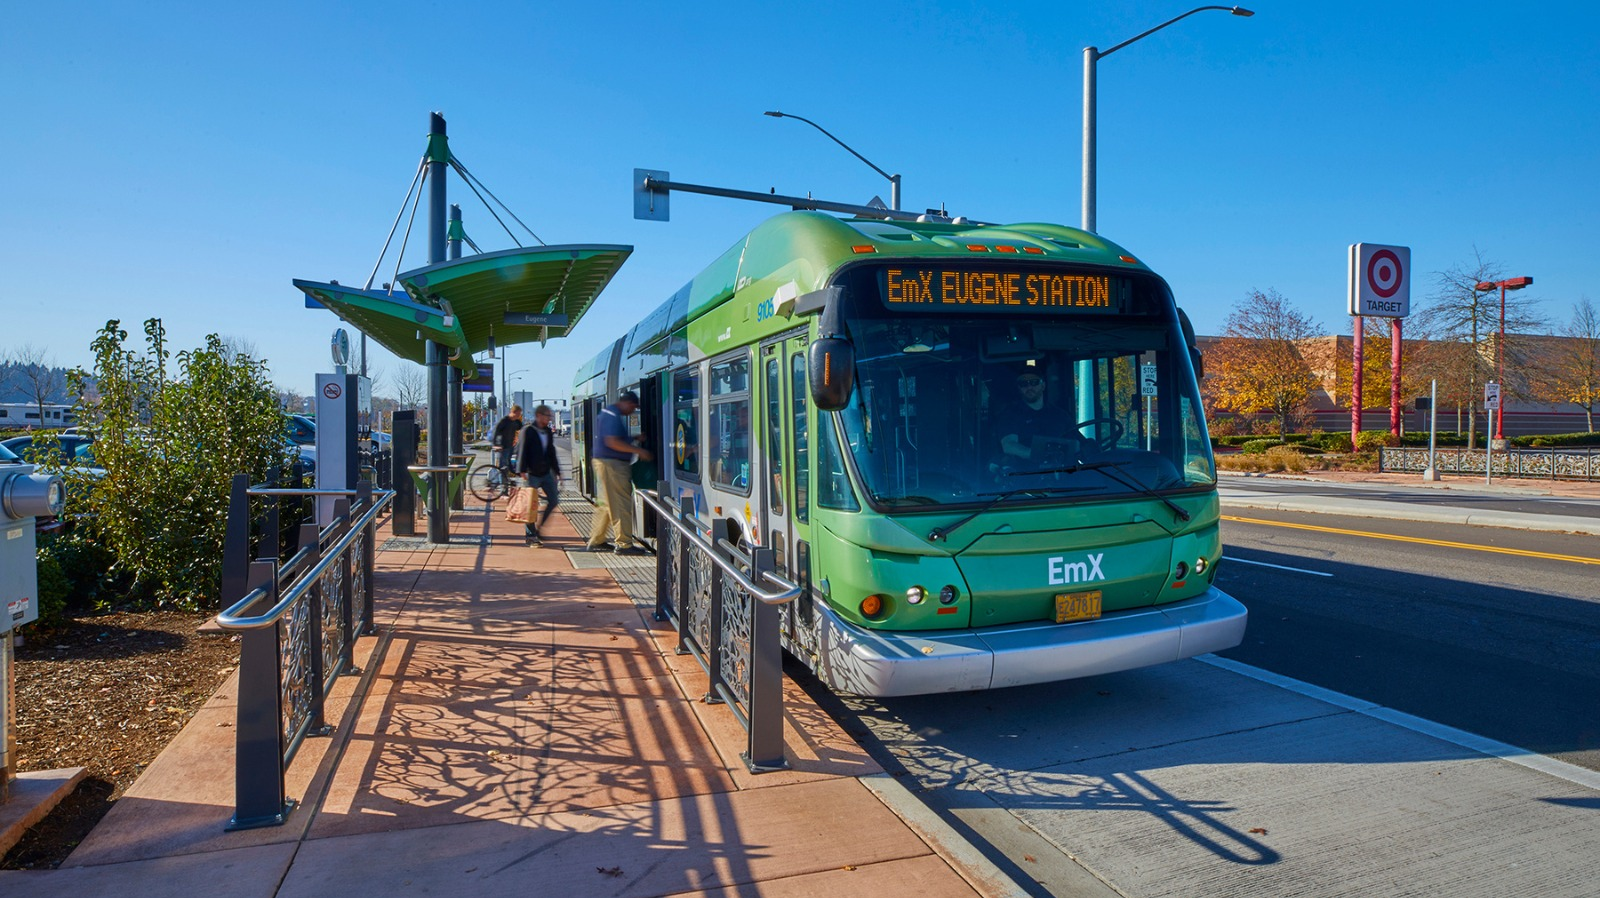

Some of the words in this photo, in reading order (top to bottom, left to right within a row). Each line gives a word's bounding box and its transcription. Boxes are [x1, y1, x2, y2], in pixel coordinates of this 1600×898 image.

[887, 269, 933, 303] EmX
[941, 271, 1021, 304] EUGENE
[1025, 274, 1109, 307] STATION
[1366, 300, 1402, 312] TARGET
[525, 315, 548, 324] Eugene
[1048, 553, 1105, 586] EmX
